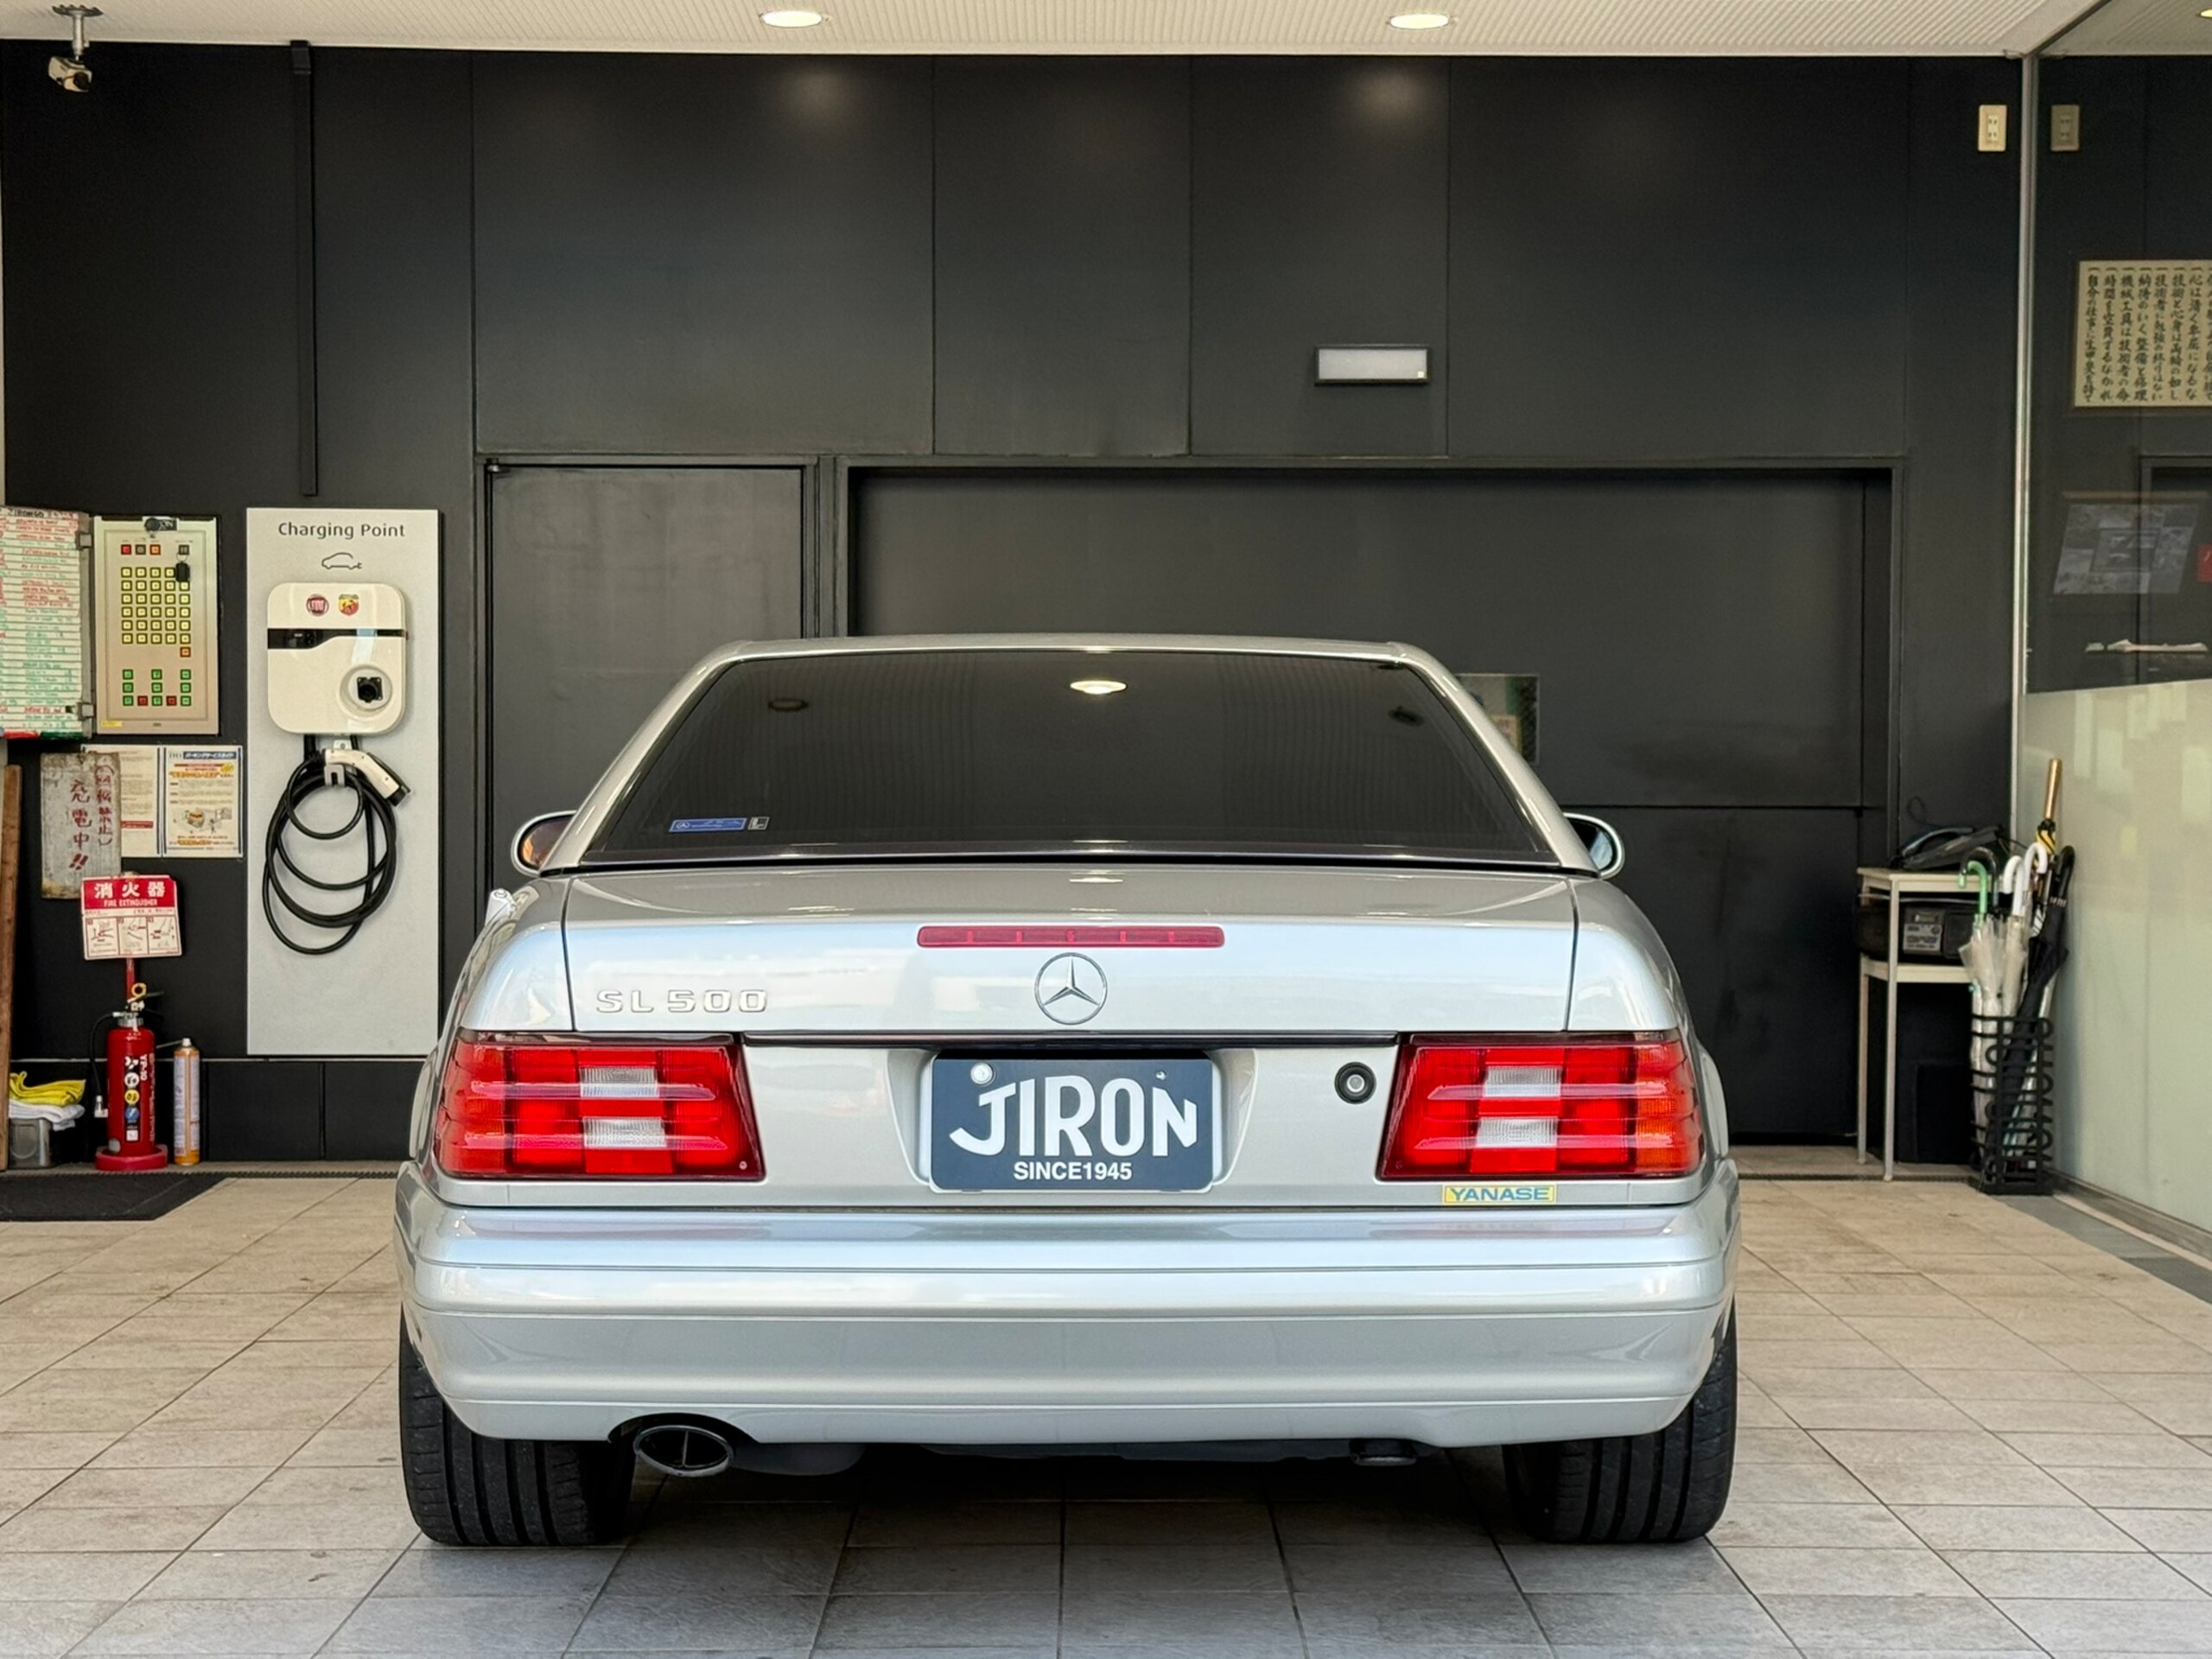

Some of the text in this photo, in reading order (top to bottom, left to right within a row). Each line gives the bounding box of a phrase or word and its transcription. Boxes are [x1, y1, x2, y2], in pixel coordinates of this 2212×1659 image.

[278, 521, 405, 540] Charging Point
[94, 881, 166, 899] 消火器
[104, 899, 118, 908] FIRE
[596, 988, 767, 1014] SL 500
[949, 1075, 1198, 1156] JIRON
[1013, 1161, 1133, 1180] SINCE1945
[1449, 1187, 1550, 1201] YANASE
